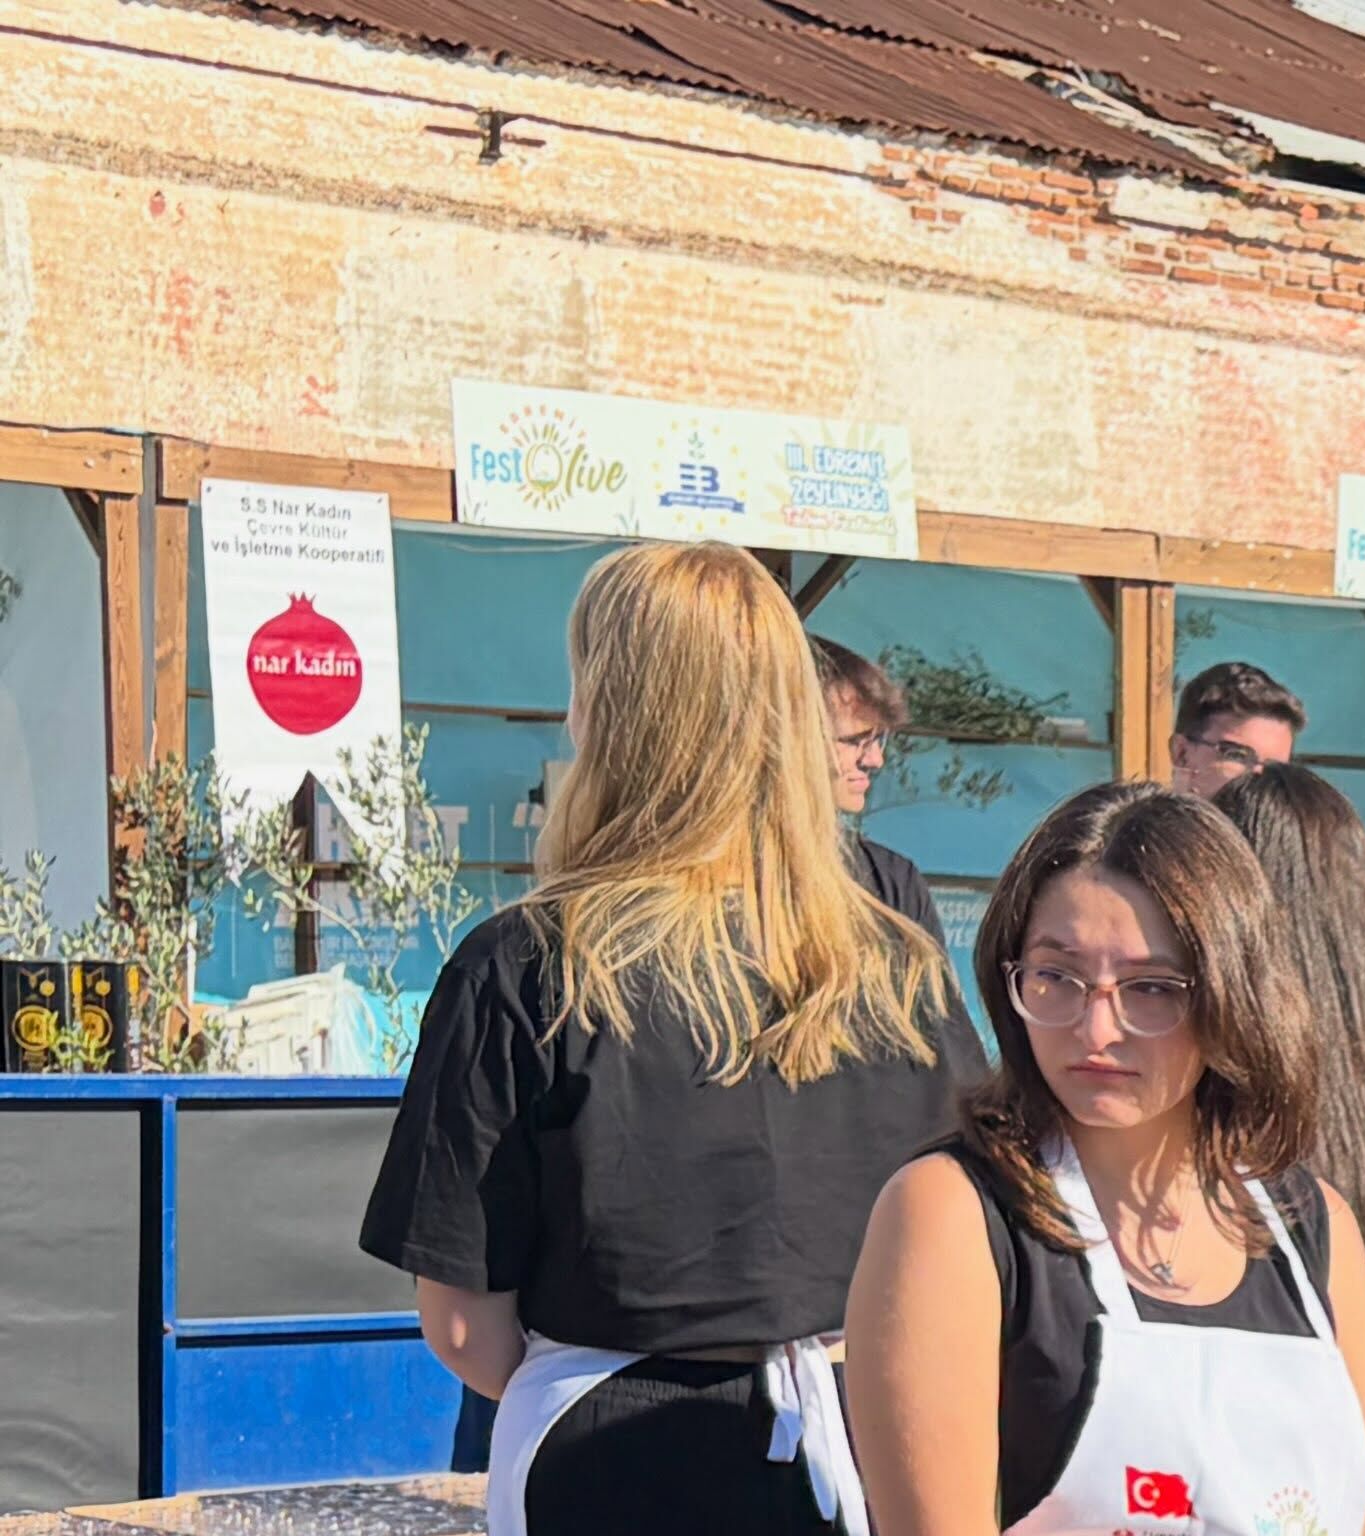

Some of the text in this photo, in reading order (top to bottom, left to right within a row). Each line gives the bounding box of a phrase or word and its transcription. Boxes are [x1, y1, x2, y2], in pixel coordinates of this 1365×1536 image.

[273, 499, 300, 516] Nar
[305, 502, 352, 521] Kadın
[247, 518, 349, 540] Çevre Kültür
[211, 535, 385, 565] ve İşletme Kooperatifi
[253, 648, 357, 677] nar kadın
